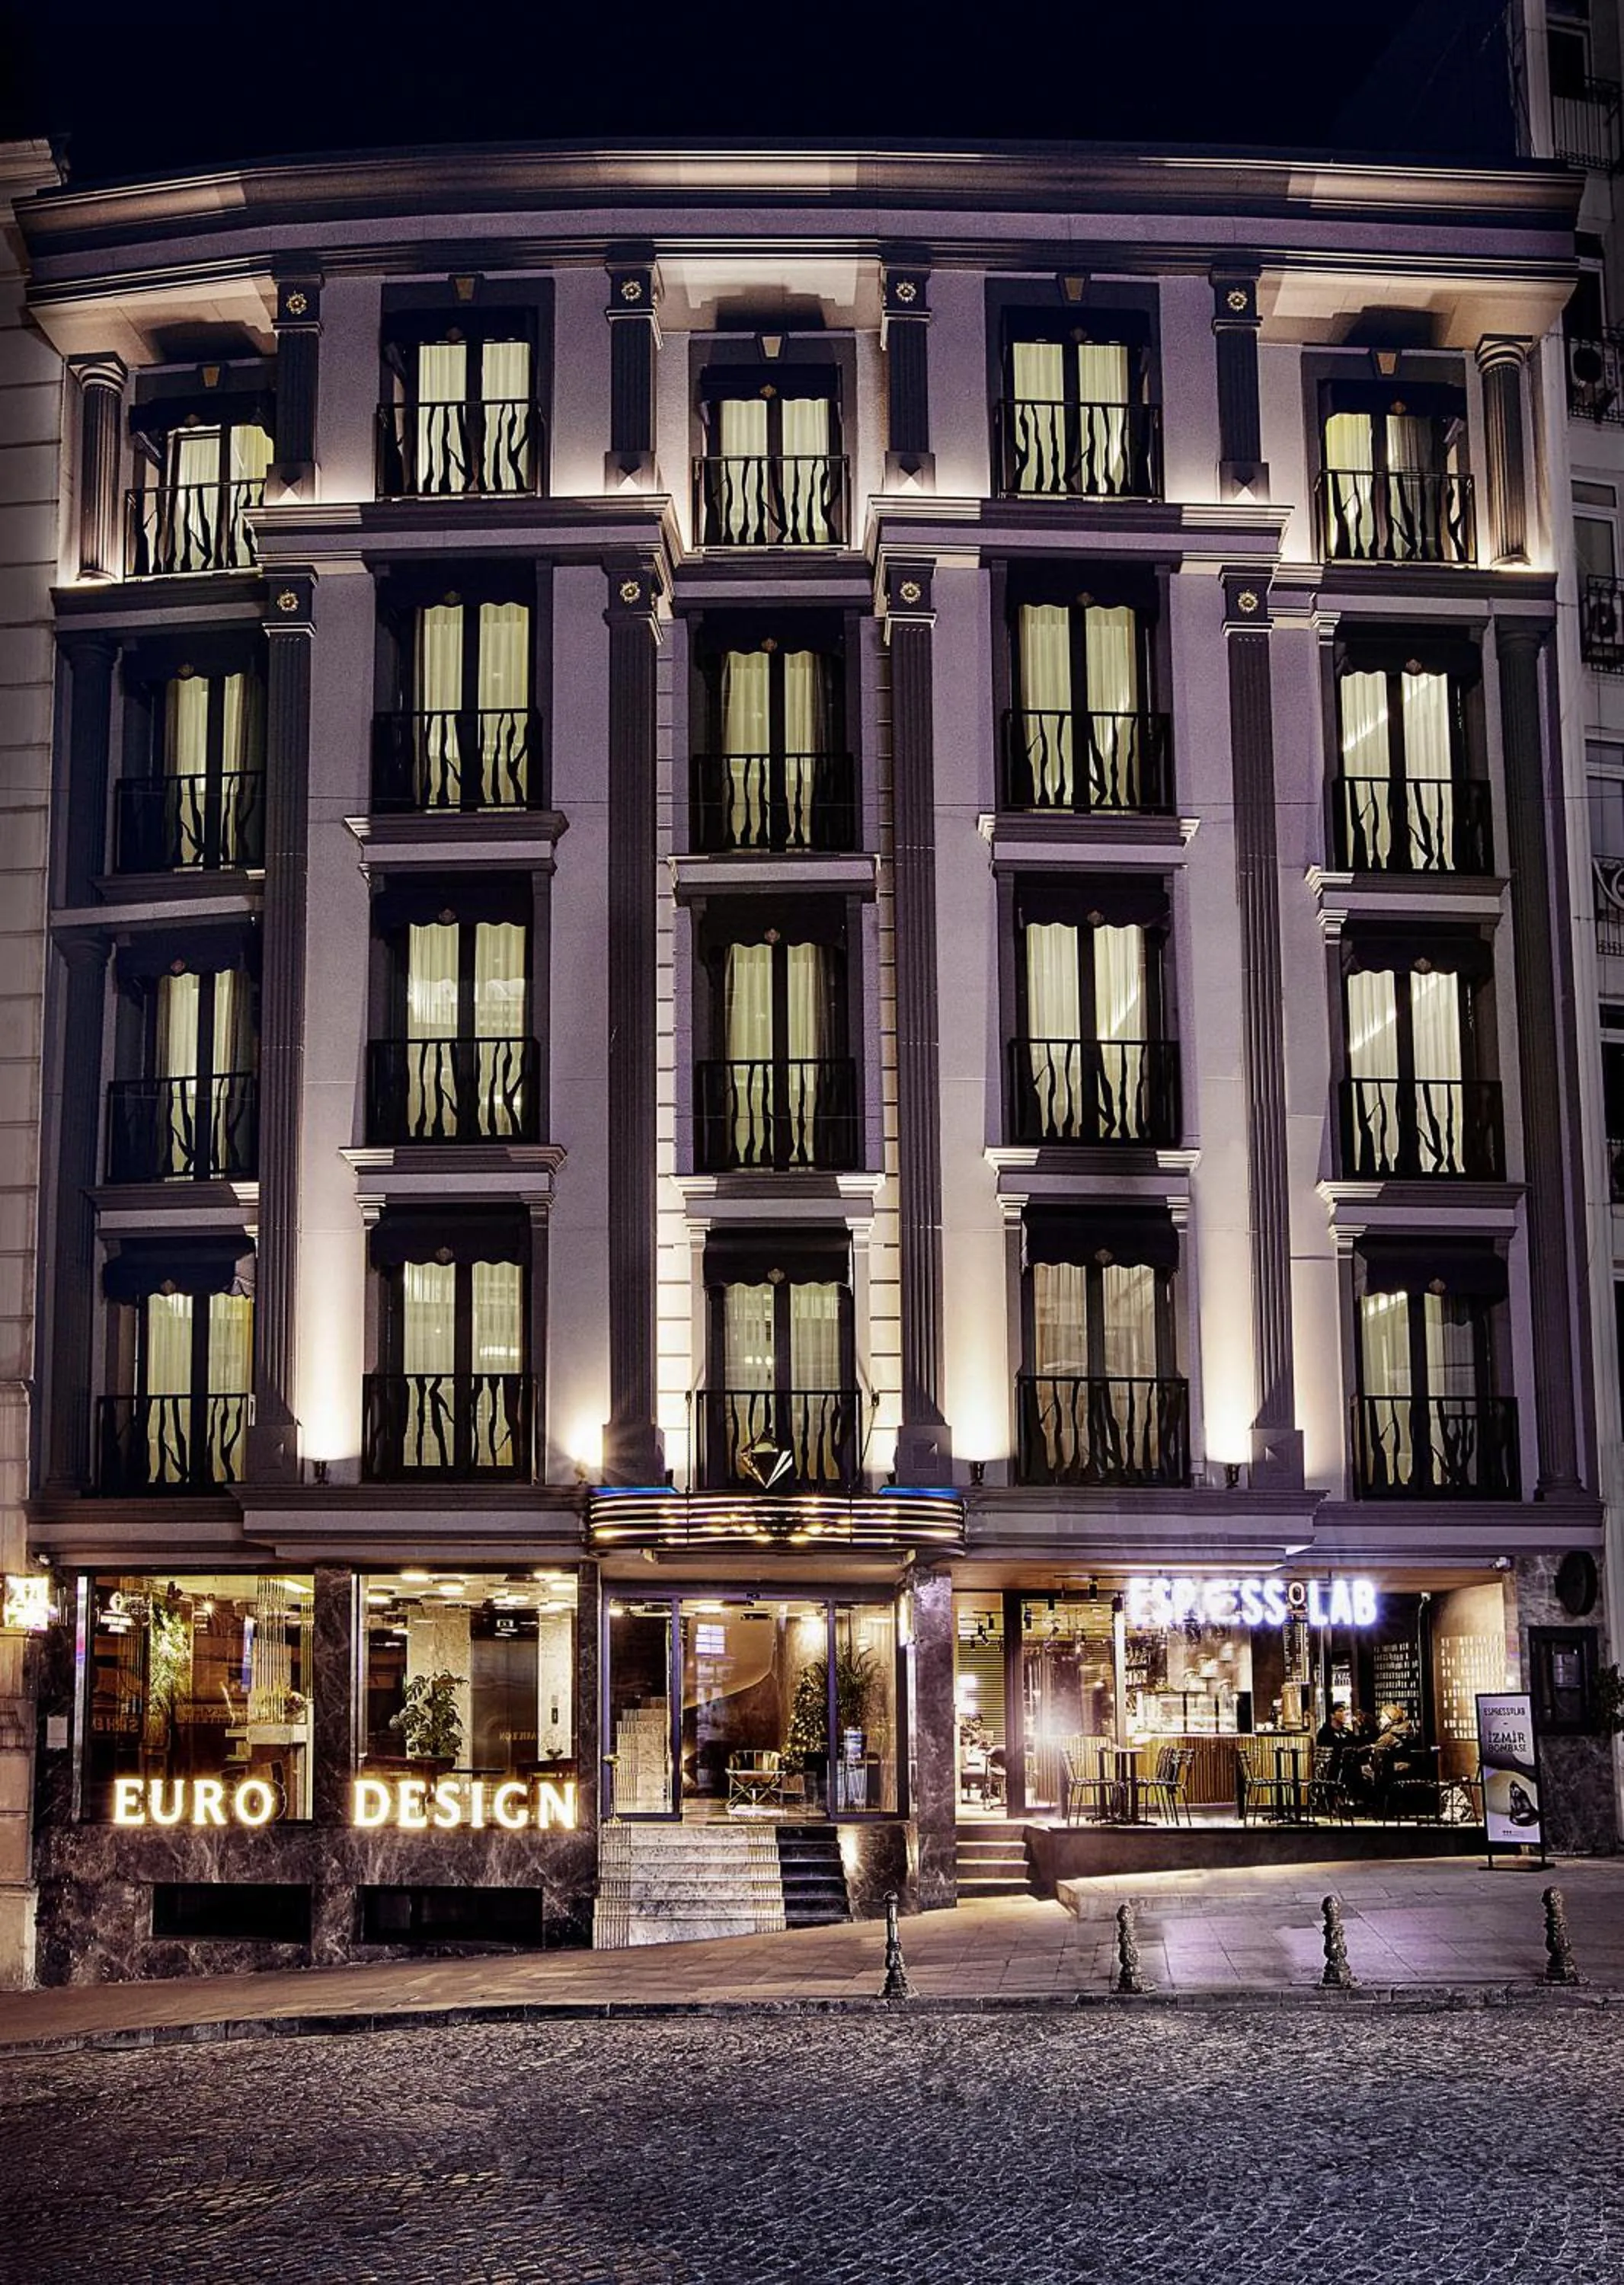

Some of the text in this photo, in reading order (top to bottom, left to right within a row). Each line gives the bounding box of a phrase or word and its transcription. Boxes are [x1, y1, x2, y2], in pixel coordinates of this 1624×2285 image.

[1488, 1730, 1526, 1743] İZMİR
[1488, 1743, 1527, 1753] BOMBASI
[114, 1778, 577, 1829] EURO DESIGN
